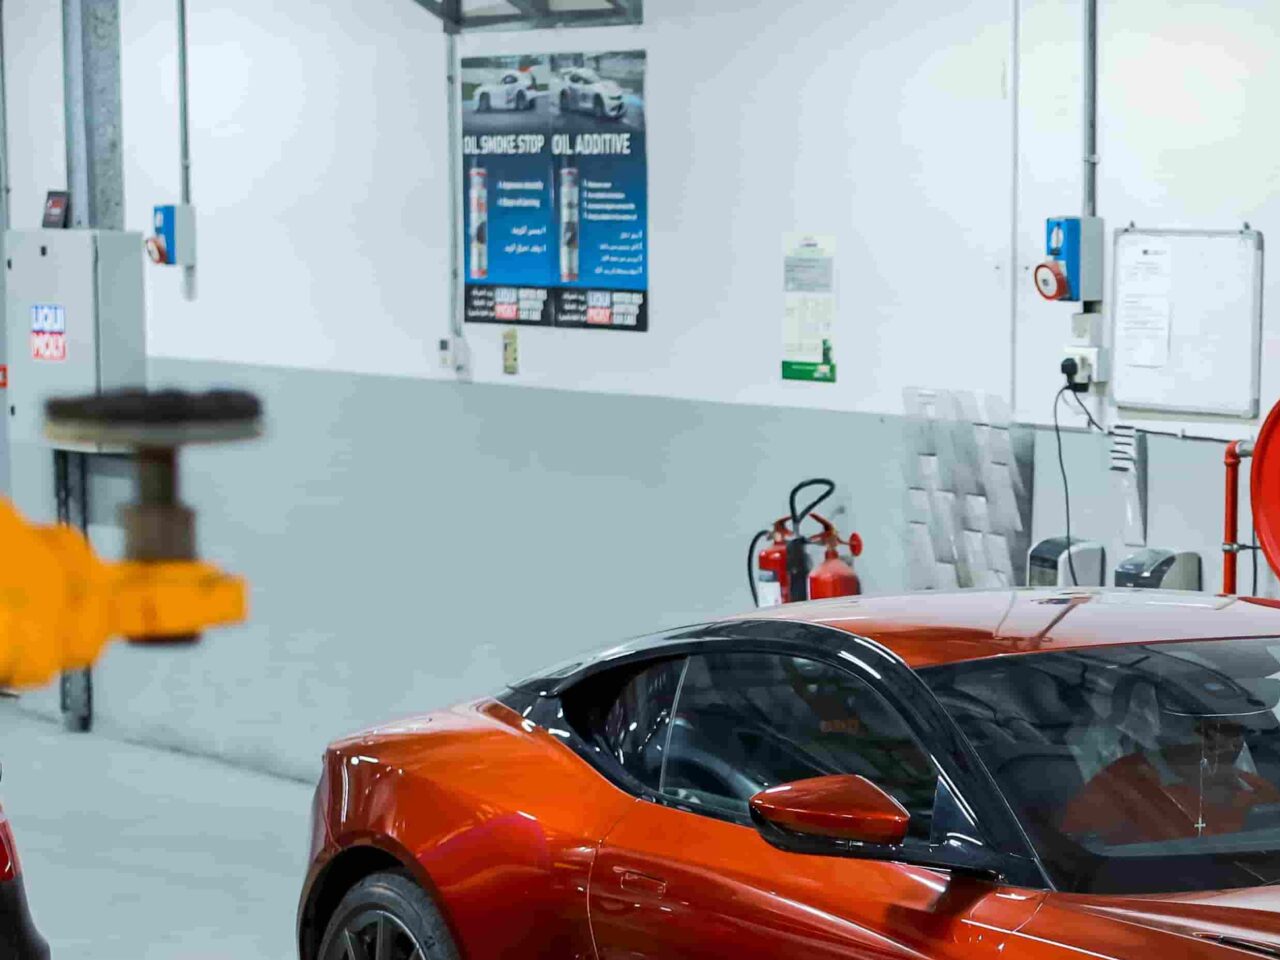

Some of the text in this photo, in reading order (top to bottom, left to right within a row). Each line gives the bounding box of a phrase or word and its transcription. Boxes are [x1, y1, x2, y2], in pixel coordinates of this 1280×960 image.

[463, 134, 545, 154] OIL SMOKE STOP
[551, 133, 631, 155] OIL ADDITIVE
